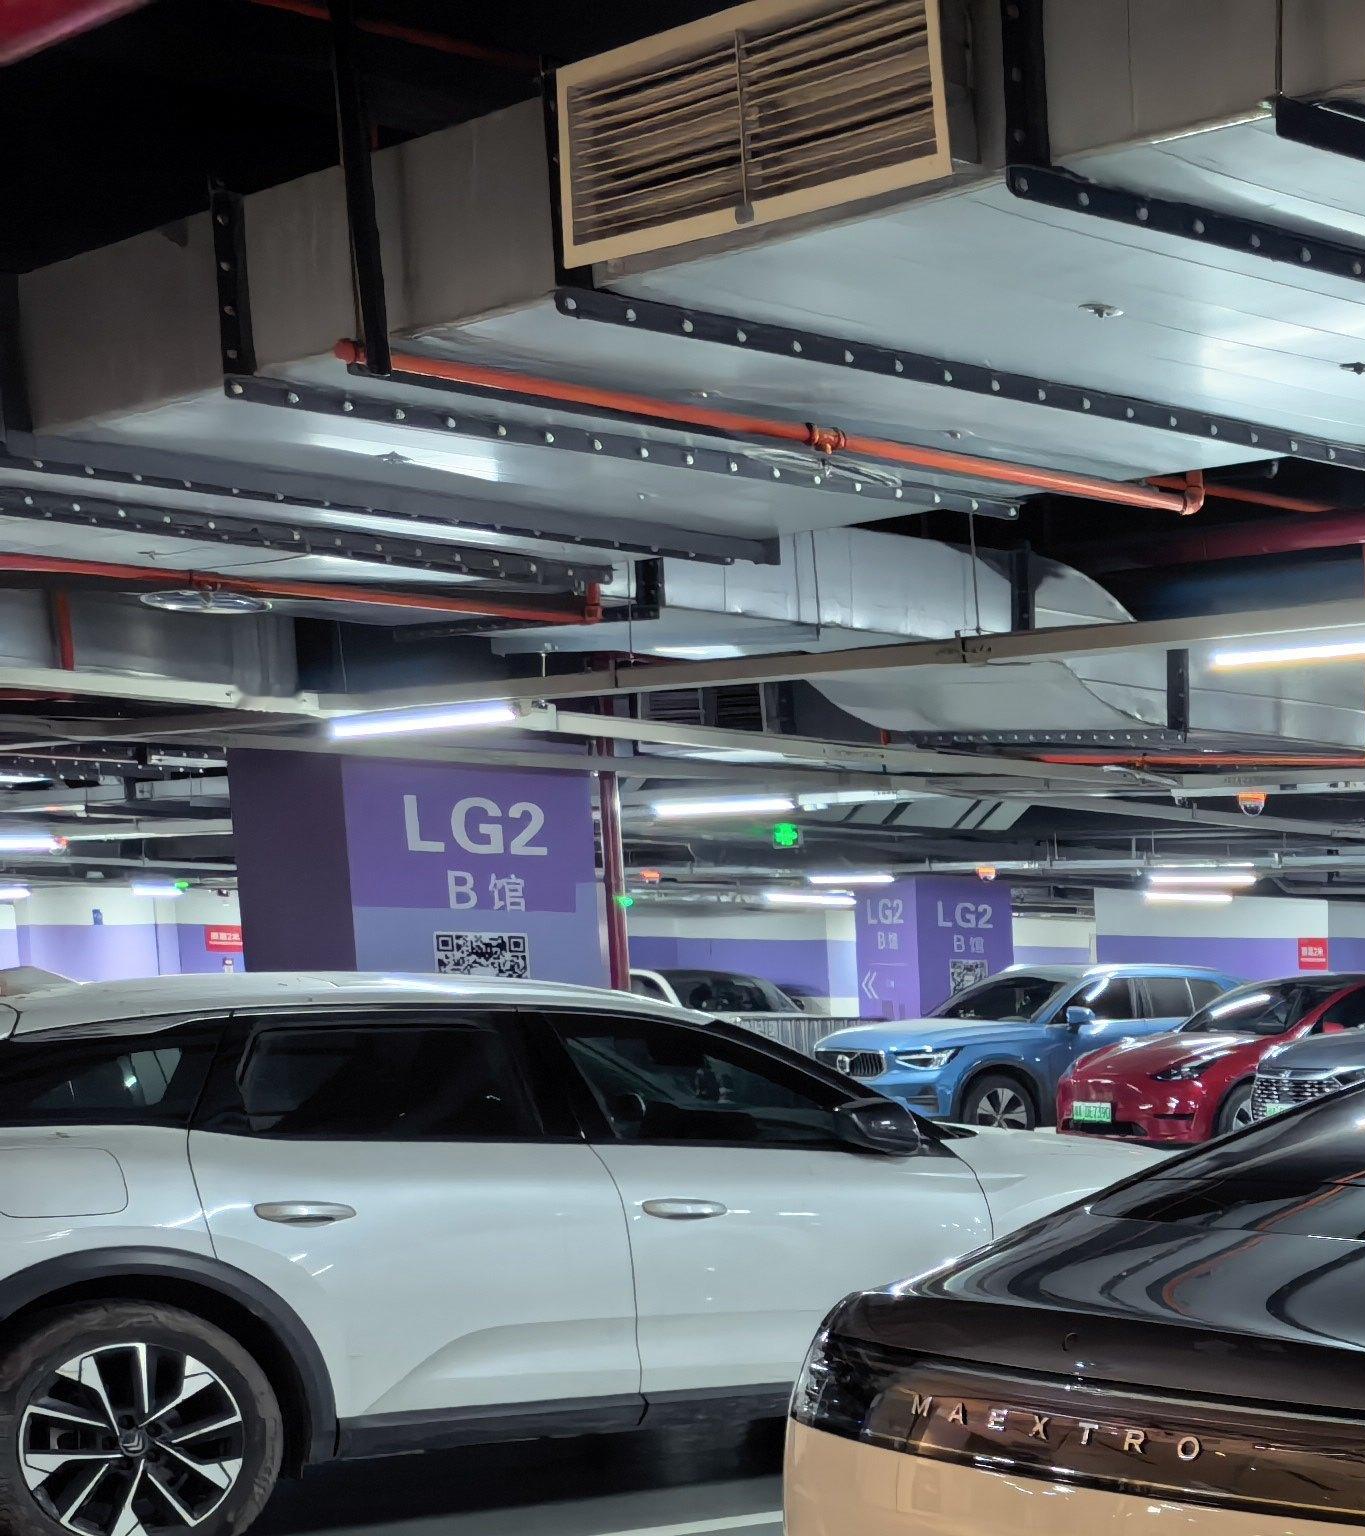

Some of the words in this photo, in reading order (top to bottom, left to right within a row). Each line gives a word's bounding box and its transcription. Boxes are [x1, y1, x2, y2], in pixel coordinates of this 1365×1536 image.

[403, 794, 548, 856] LG2
[866, 898, 904, 925] LG2
[936, 900, 994, 929] LG2
[911, 1393, 1201, 1460] MAEXTRO
